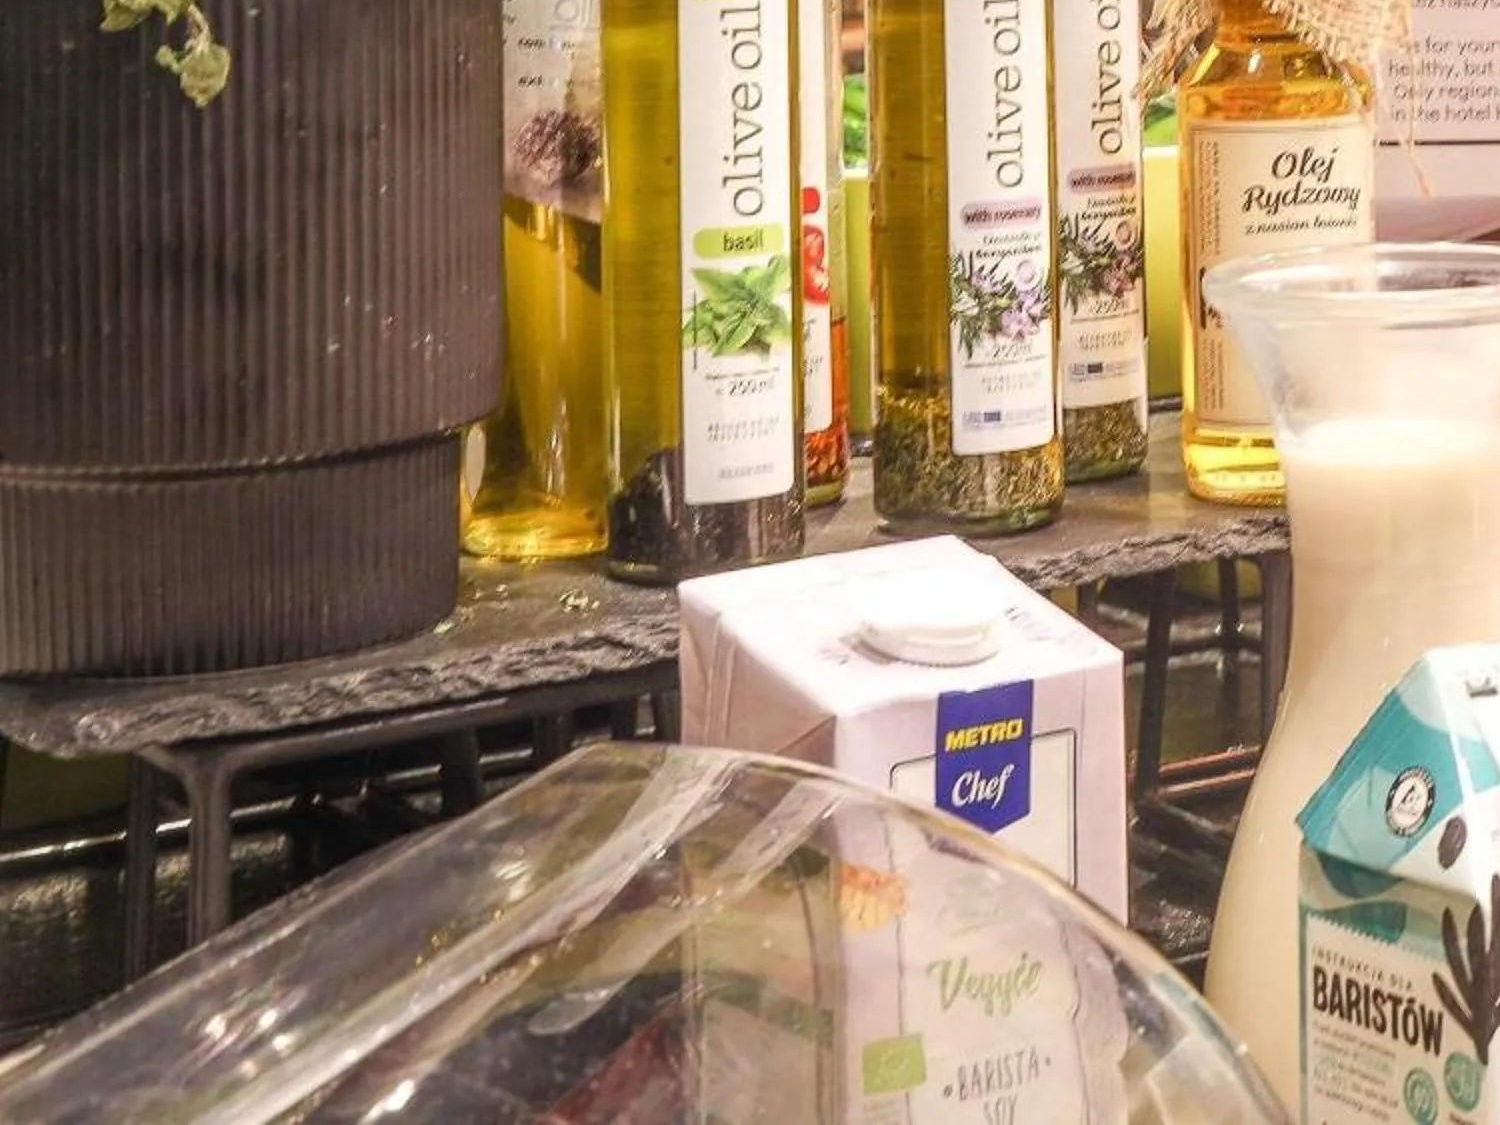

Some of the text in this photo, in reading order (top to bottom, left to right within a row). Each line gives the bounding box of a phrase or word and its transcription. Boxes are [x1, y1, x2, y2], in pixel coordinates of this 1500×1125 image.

[1425, 35, 1451, 53] for
[1464, 57, 1494, 76] but
[1090, 39, 1123, 156] olive
[1445, 103, 1491, 121] hotel
[986, 64, 1024, 189] olive
[722, 80, 763, 217] olive
[1270, 145, 1340, 184] Olej
[1241, 180, 1362, 216] Rydzowy
[722, 230, 764, 252] basil
[945, 718, 1023, 752] METRO
[951, 762, 1016, 809] Chef
[925, 951, 1043, 1017] Veggie
[1312, 965, 1444, 1057] BARISTÓW
[957, 1046, 1040, 1101] BARISTA
